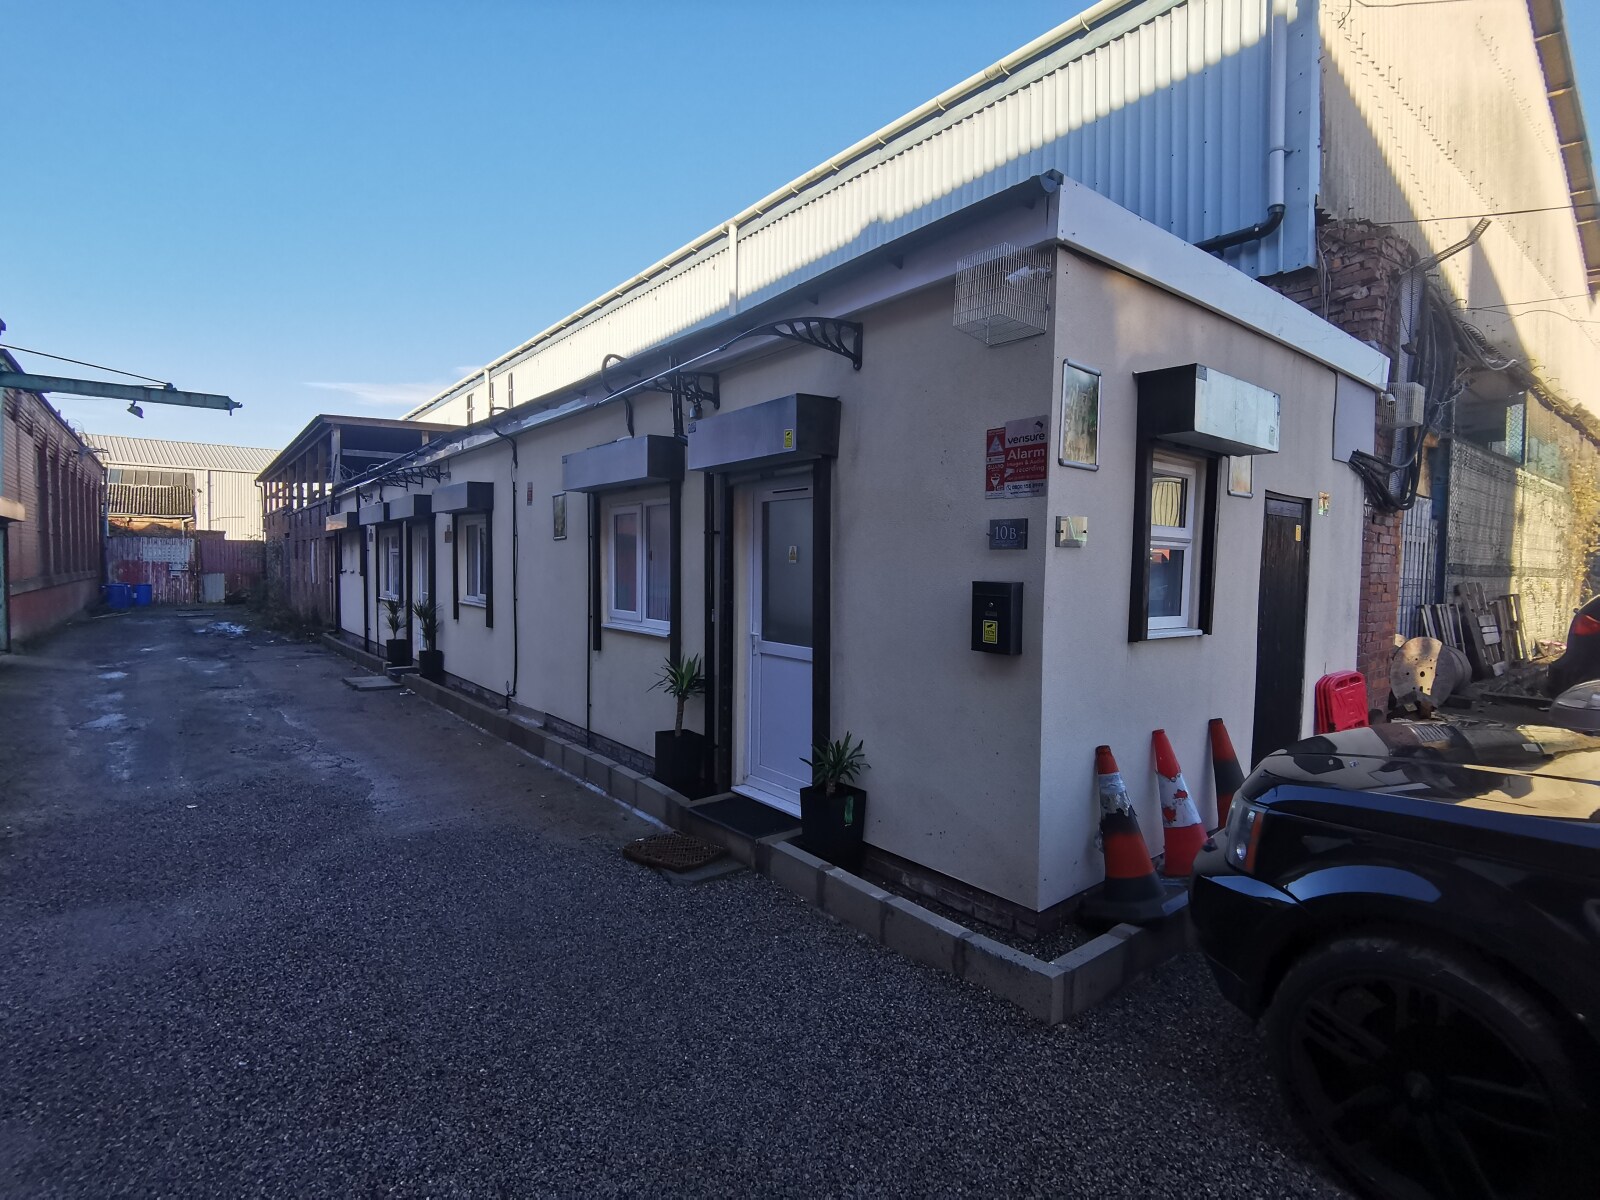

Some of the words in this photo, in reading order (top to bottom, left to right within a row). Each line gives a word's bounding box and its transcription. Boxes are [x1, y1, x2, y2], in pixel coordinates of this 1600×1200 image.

[1007, 432, 1045, 443] verisure
[1007, 448, 1045, 461] Alarm
[1016, 465, 1045, 473] recording
[994, 525, 1017, 540] 10B
